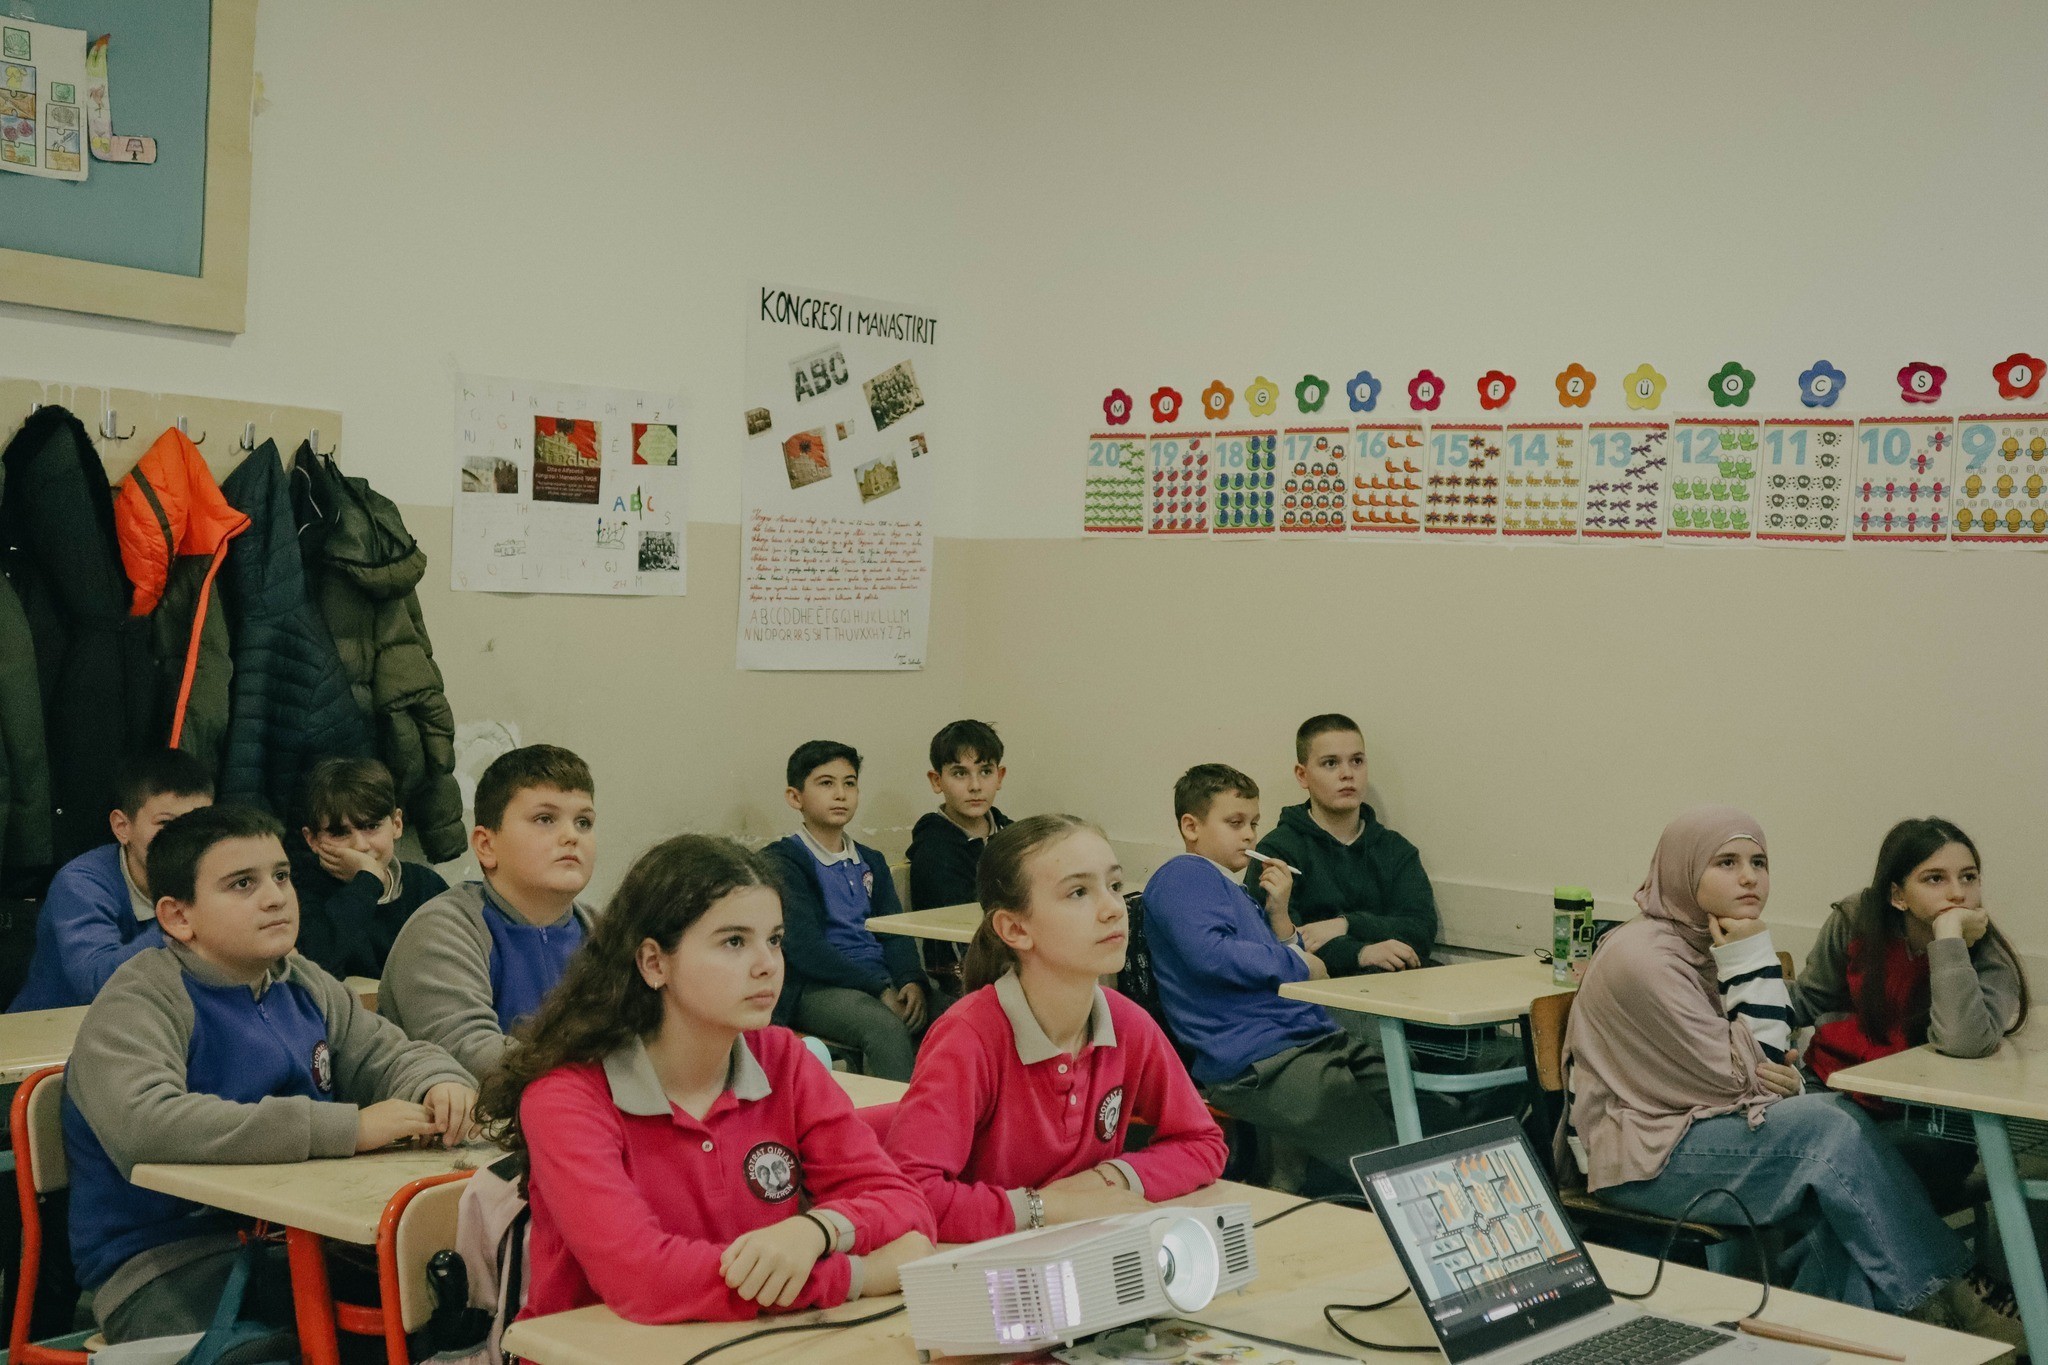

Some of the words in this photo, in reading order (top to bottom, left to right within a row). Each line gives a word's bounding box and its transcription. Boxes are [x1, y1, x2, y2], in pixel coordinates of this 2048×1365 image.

[762, 287, 842, 331] KONGRESI
[858, 311, 937, 344] MANASTIRIT
[795, 352, 848, 401] ABC
[1572, 381, 1579, 393] Z
[1727, 379, 1738, 391] O
[1816, 380, 1827, 391] C
[1918, 376, 1926, 388] S
[2016, 369, 2023, 382] J
[1258, 392, 1266, 403] G
[1361, 388, 1366, 398] L
[1422, 387, 1430, 397] H
[1494, 385, 1499, 395] F
[1641, 381, 1650, 395] Ü
[1114, 404, 1122, 413] M
[1163, 401, 1170, 411] U
[1215, 395, 1222, 407] D
[1089, 442, 1120, 467] 20
[1152, 442, 1180, 466] 19
[1217, 442, 1244, 467] 18
[1284, 436, 1314, 460] 17
[1357, 432, 1387, 457] 16
[1431, 434, 1468, 467] 15
[1507, 434, 1549, 466] 14
[1590, 434, 1632, 467] 13
[1675, 428, 1720, 464] 12
[1766, 429, 1808, 465] 11
[1860, 428, 1911, 465] 10
[1962, 424, 1997, 470] 9
[1099, 1090, 1117, 1120] MOTRAT
[749, 1148, 764, 1180] MOTRAT
[768, 1147, 795, 1169] QIRIAZI
[765, 1183, 793, 1199] PRIZREN
